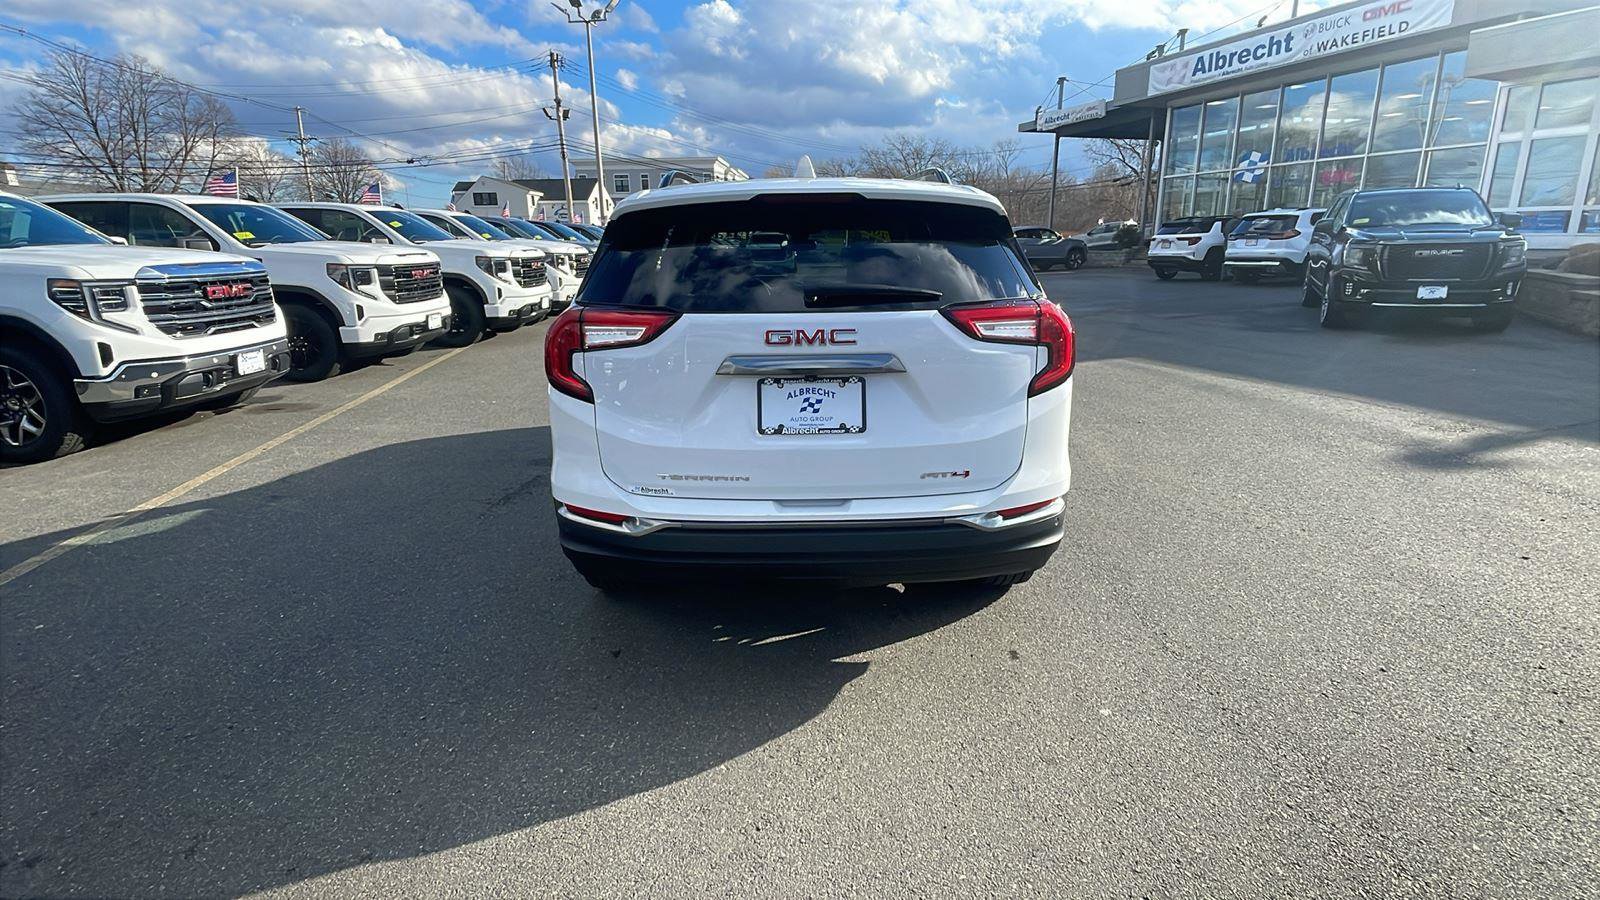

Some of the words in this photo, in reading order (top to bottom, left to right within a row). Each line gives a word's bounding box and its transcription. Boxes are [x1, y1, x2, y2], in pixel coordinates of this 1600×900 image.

[1318, 15, 1352, 34] BUICK
[1362, 0, 1413, 22] GMC
[1316, 20, 1410, 53] WAKEFIELD
[1191, 31, 1295, 78] Albrecht
[206, 283, 254, 299] GMC
[765, 328, 858, 346] GMC
[786, 387, 837, 400] ALBRECHT
[782, 427, 819, 435] Albrecht
[656, 473, 750, 482] TERRAIN
[640, 486, 669, 495] Albrecht
